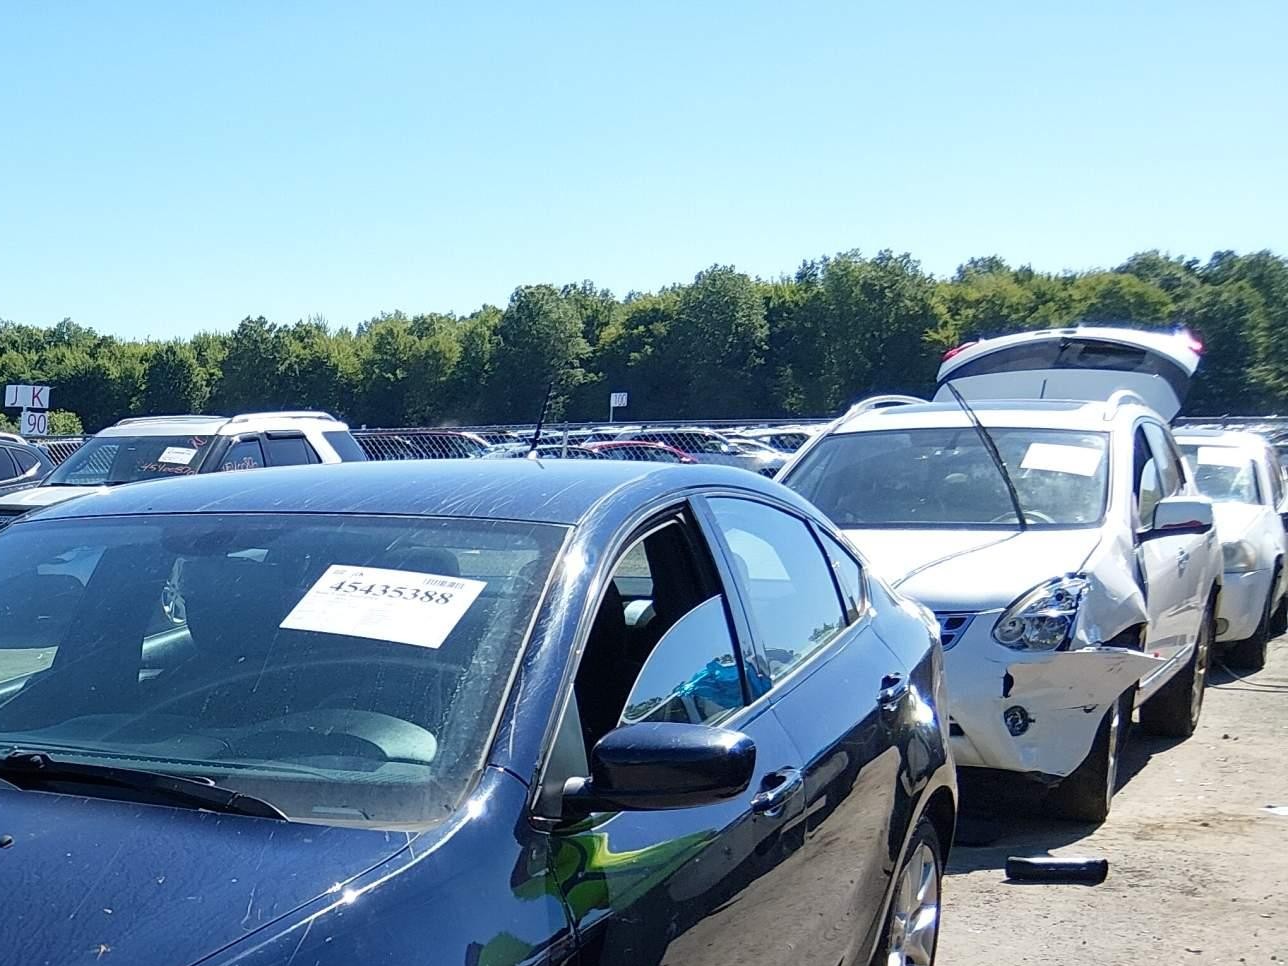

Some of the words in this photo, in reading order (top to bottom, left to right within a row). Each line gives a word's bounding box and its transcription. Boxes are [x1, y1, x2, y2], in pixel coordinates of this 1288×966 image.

[10, 386, 18, 406] J
[32, 386, 44, 407] K
[27, 414, 47, 434] 90
[330, 580, 453, 604] 45435388
